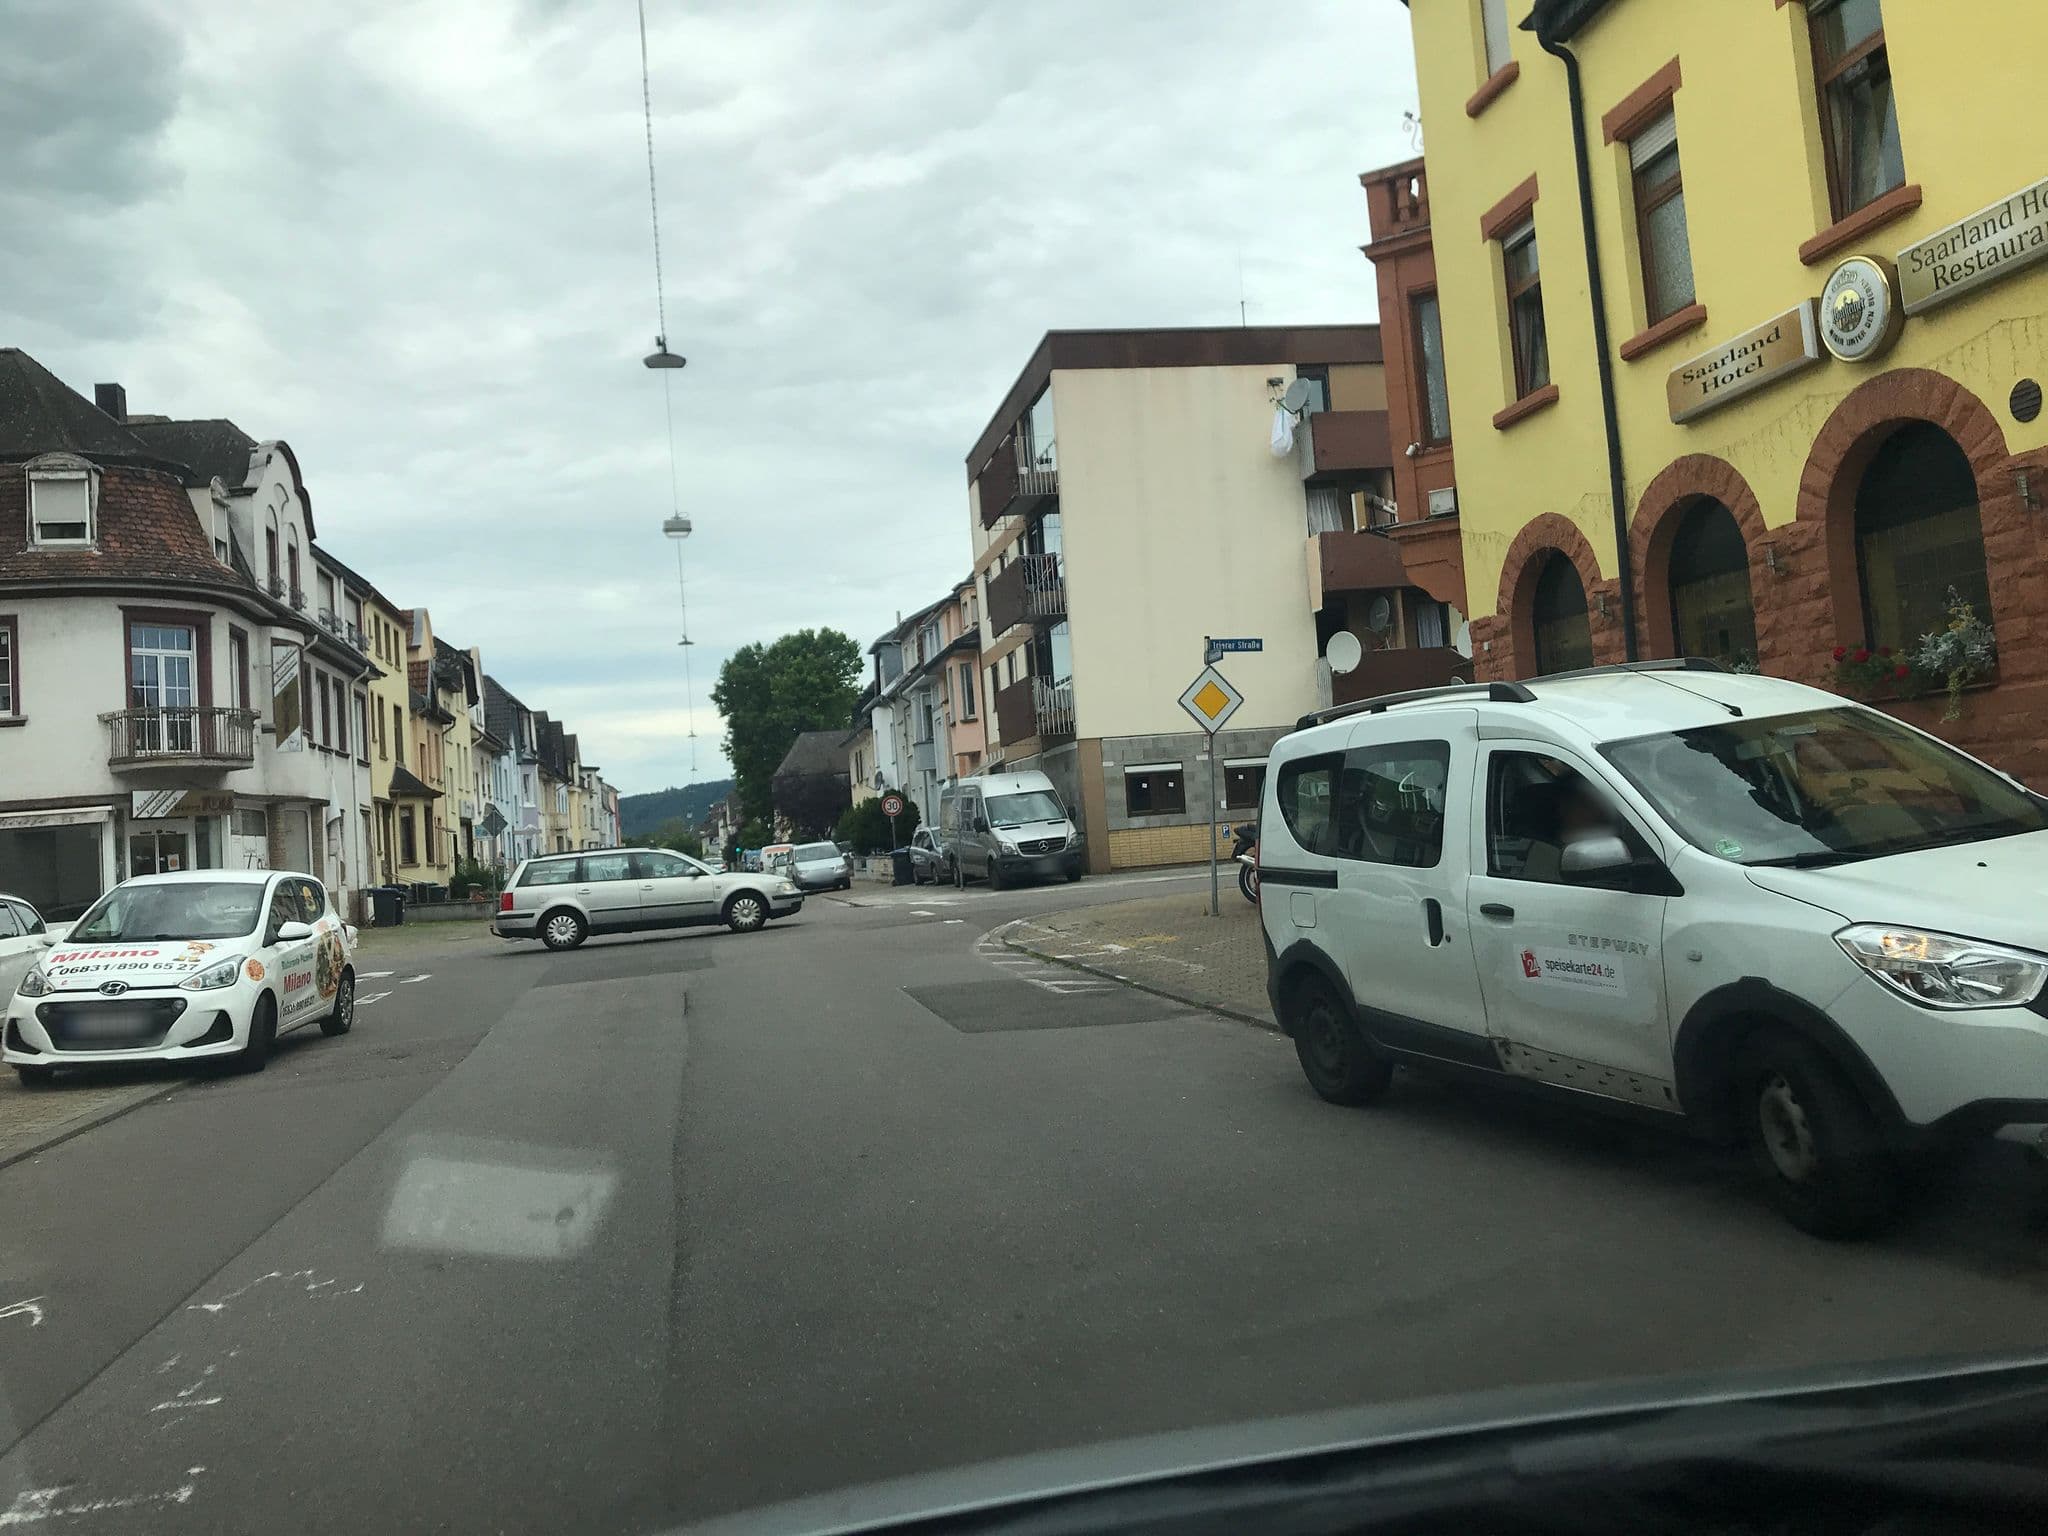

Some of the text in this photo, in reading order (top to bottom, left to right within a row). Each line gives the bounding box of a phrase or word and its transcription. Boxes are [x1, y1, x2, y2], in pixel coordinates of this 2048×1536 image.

[1910, 200, 2015, 274] Saarland
[1931, 221, 2048, 290] Restaura
[1681, 325, 1781, 385] Saarland
[1701, 353, 1764, 395] Hotel
[1237, 641, 1261, 649] Straße
[886, 801, 898, 811] 30
[50, 949, 160, 963] Milano
[1568, 933, 1649, 956] STEPWAY
[59, 962, 199, 976] 06831/890 65 27
[1545, 958, 1615, 978] speisekarte24.de
[284, 971, 311, 994] Milano
